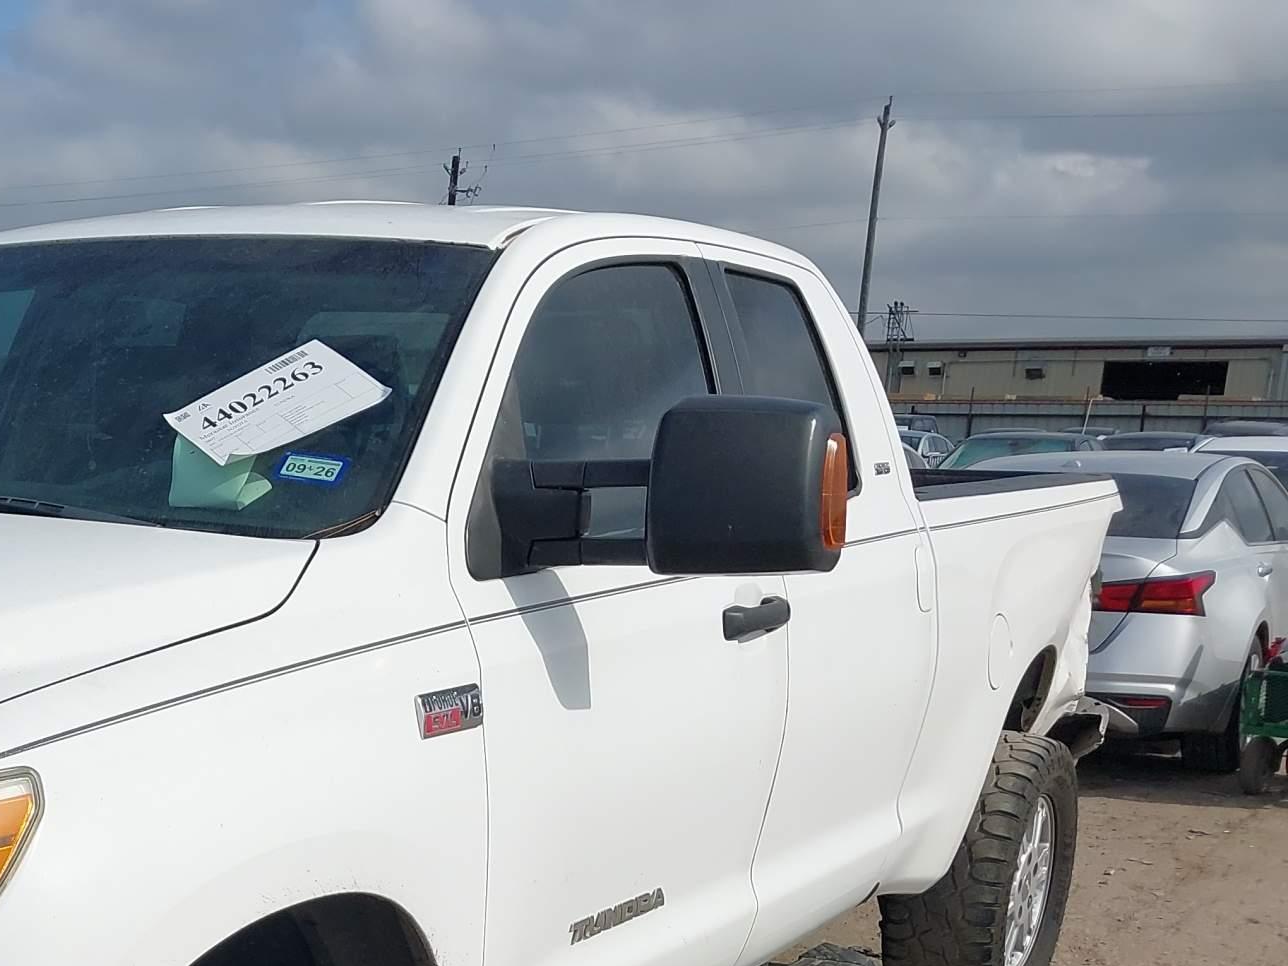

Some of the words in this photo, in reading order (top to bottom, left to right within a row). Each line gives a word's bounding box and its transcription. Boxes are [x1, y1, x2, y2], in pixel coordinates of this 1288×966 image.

[201, 360, 325, 431] 44022263
[285, 462, 307, 474] 09
[313, 466, 337, 478] 26
[568, 887, 665, 945] TUNDRA
